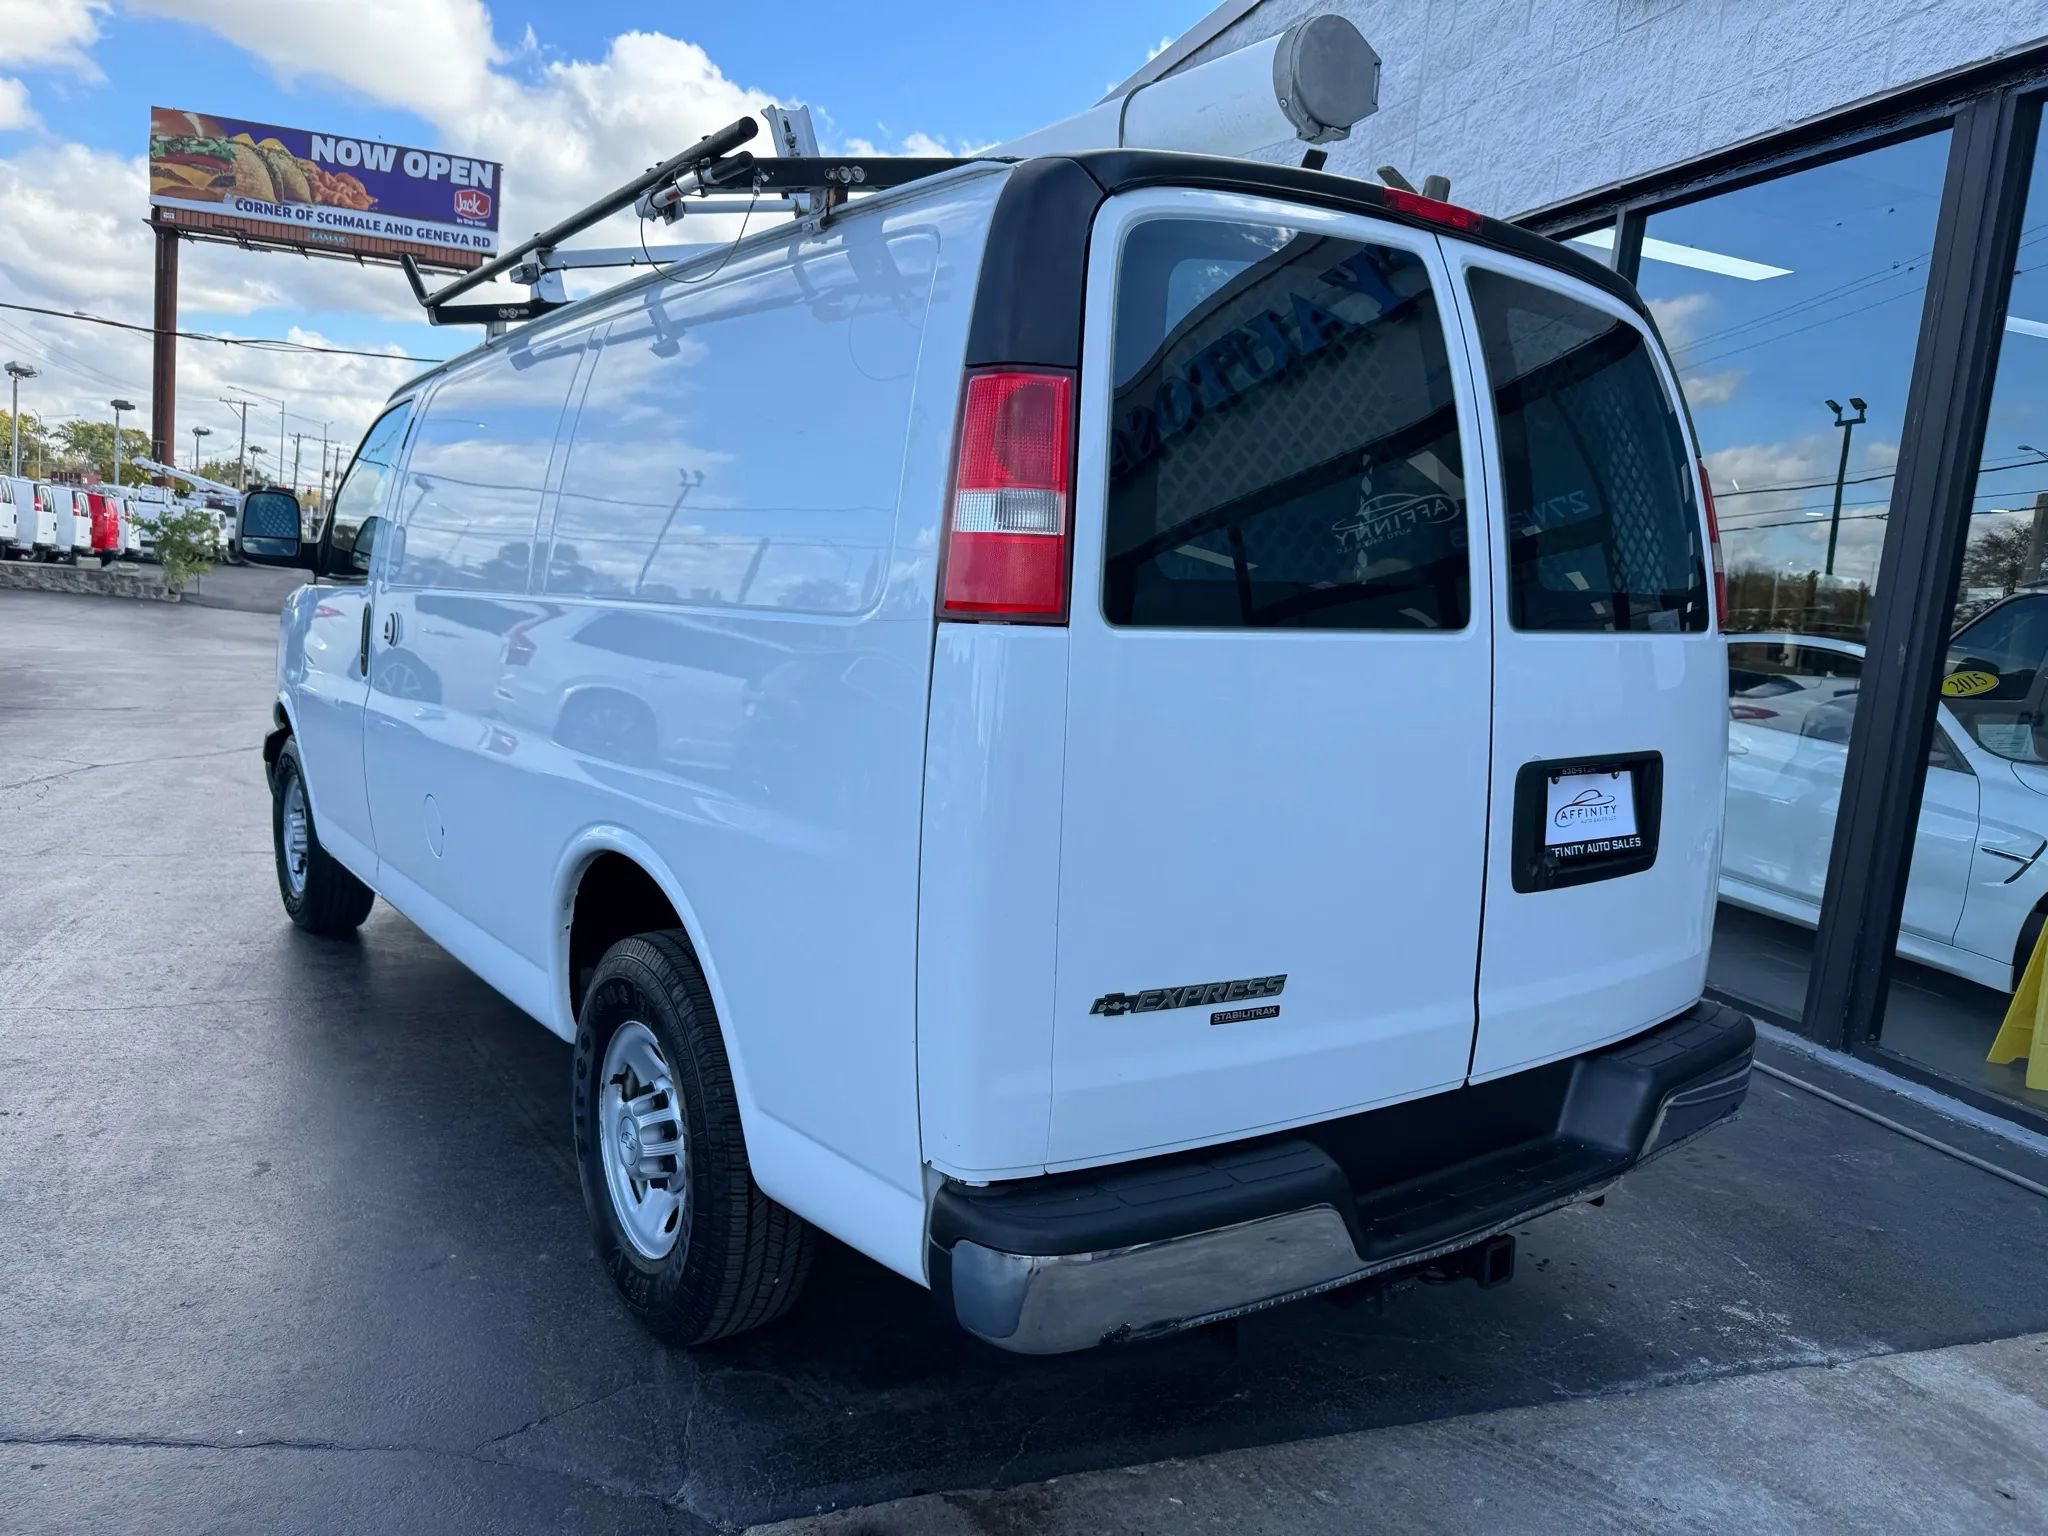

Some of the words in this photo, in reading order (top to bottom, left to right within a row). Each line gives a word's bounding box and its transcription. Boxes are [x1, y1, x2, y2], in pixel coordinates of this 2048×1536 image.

[311, 135, 398, 173] NOW
[403, 151, 494, 189] OPEN
[456, 193, 488, 216] Jack
[235, 199, 292, 219] CORNER
[295, 208, 314, 221] OF
[317, 212, 381, 231] SCHMALE
[384, 222, 413, 236] AND
[416, 228, 472, 246] GENEVA
[473, 236, 491, 248] RD
[1948, 673, 1987, 693] 2015
[1560, 804, 1617, 820] AFFINITY
[1552, 844, 1585, 858] FINITY
[1586, 841, 1610, 854] AUTO
[1612, 837, 1641, 850] SALES
[1134, 975, 1287, 1013] EXPRESS
[1213, 1006, 1278, 1021] STABILITRAK
